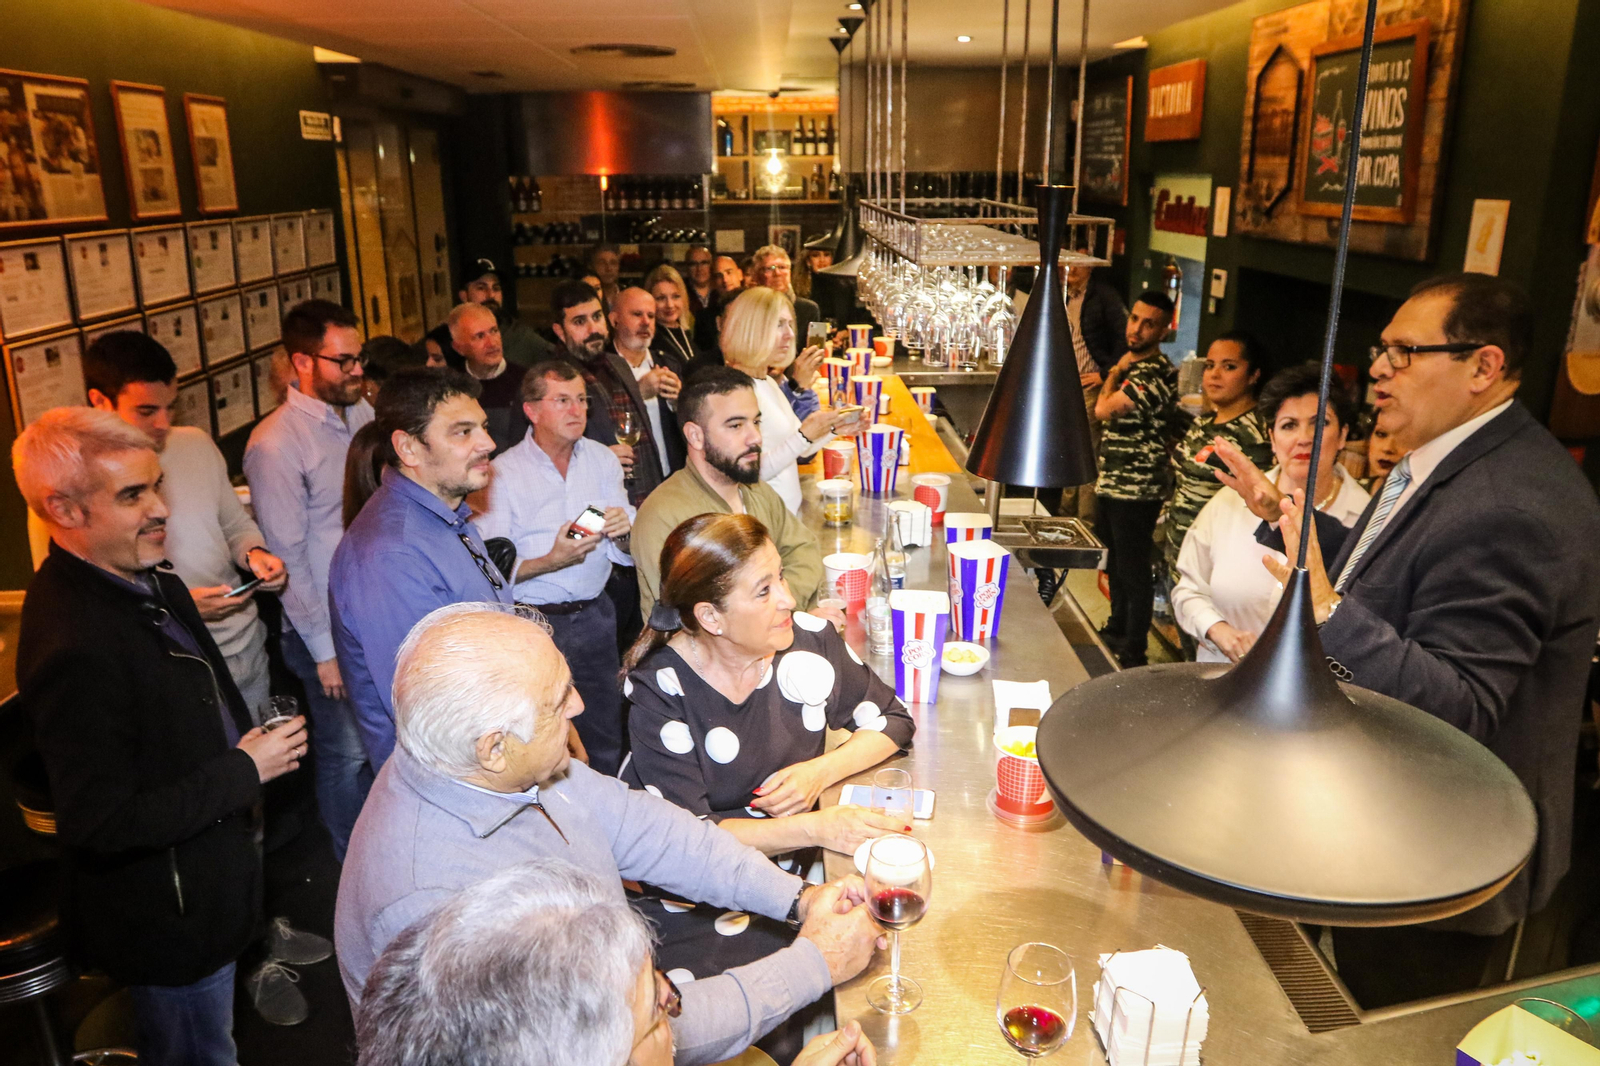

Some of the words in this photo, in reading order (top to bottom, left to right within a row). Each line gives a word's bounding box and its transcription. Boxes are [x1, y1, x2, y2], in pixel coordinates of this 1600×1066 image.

[1149, 80, 1192, 118] VICTORIA
[1361, 87, 1408, 131] VINOS
[1372, 154, 1400, 187] COPA
